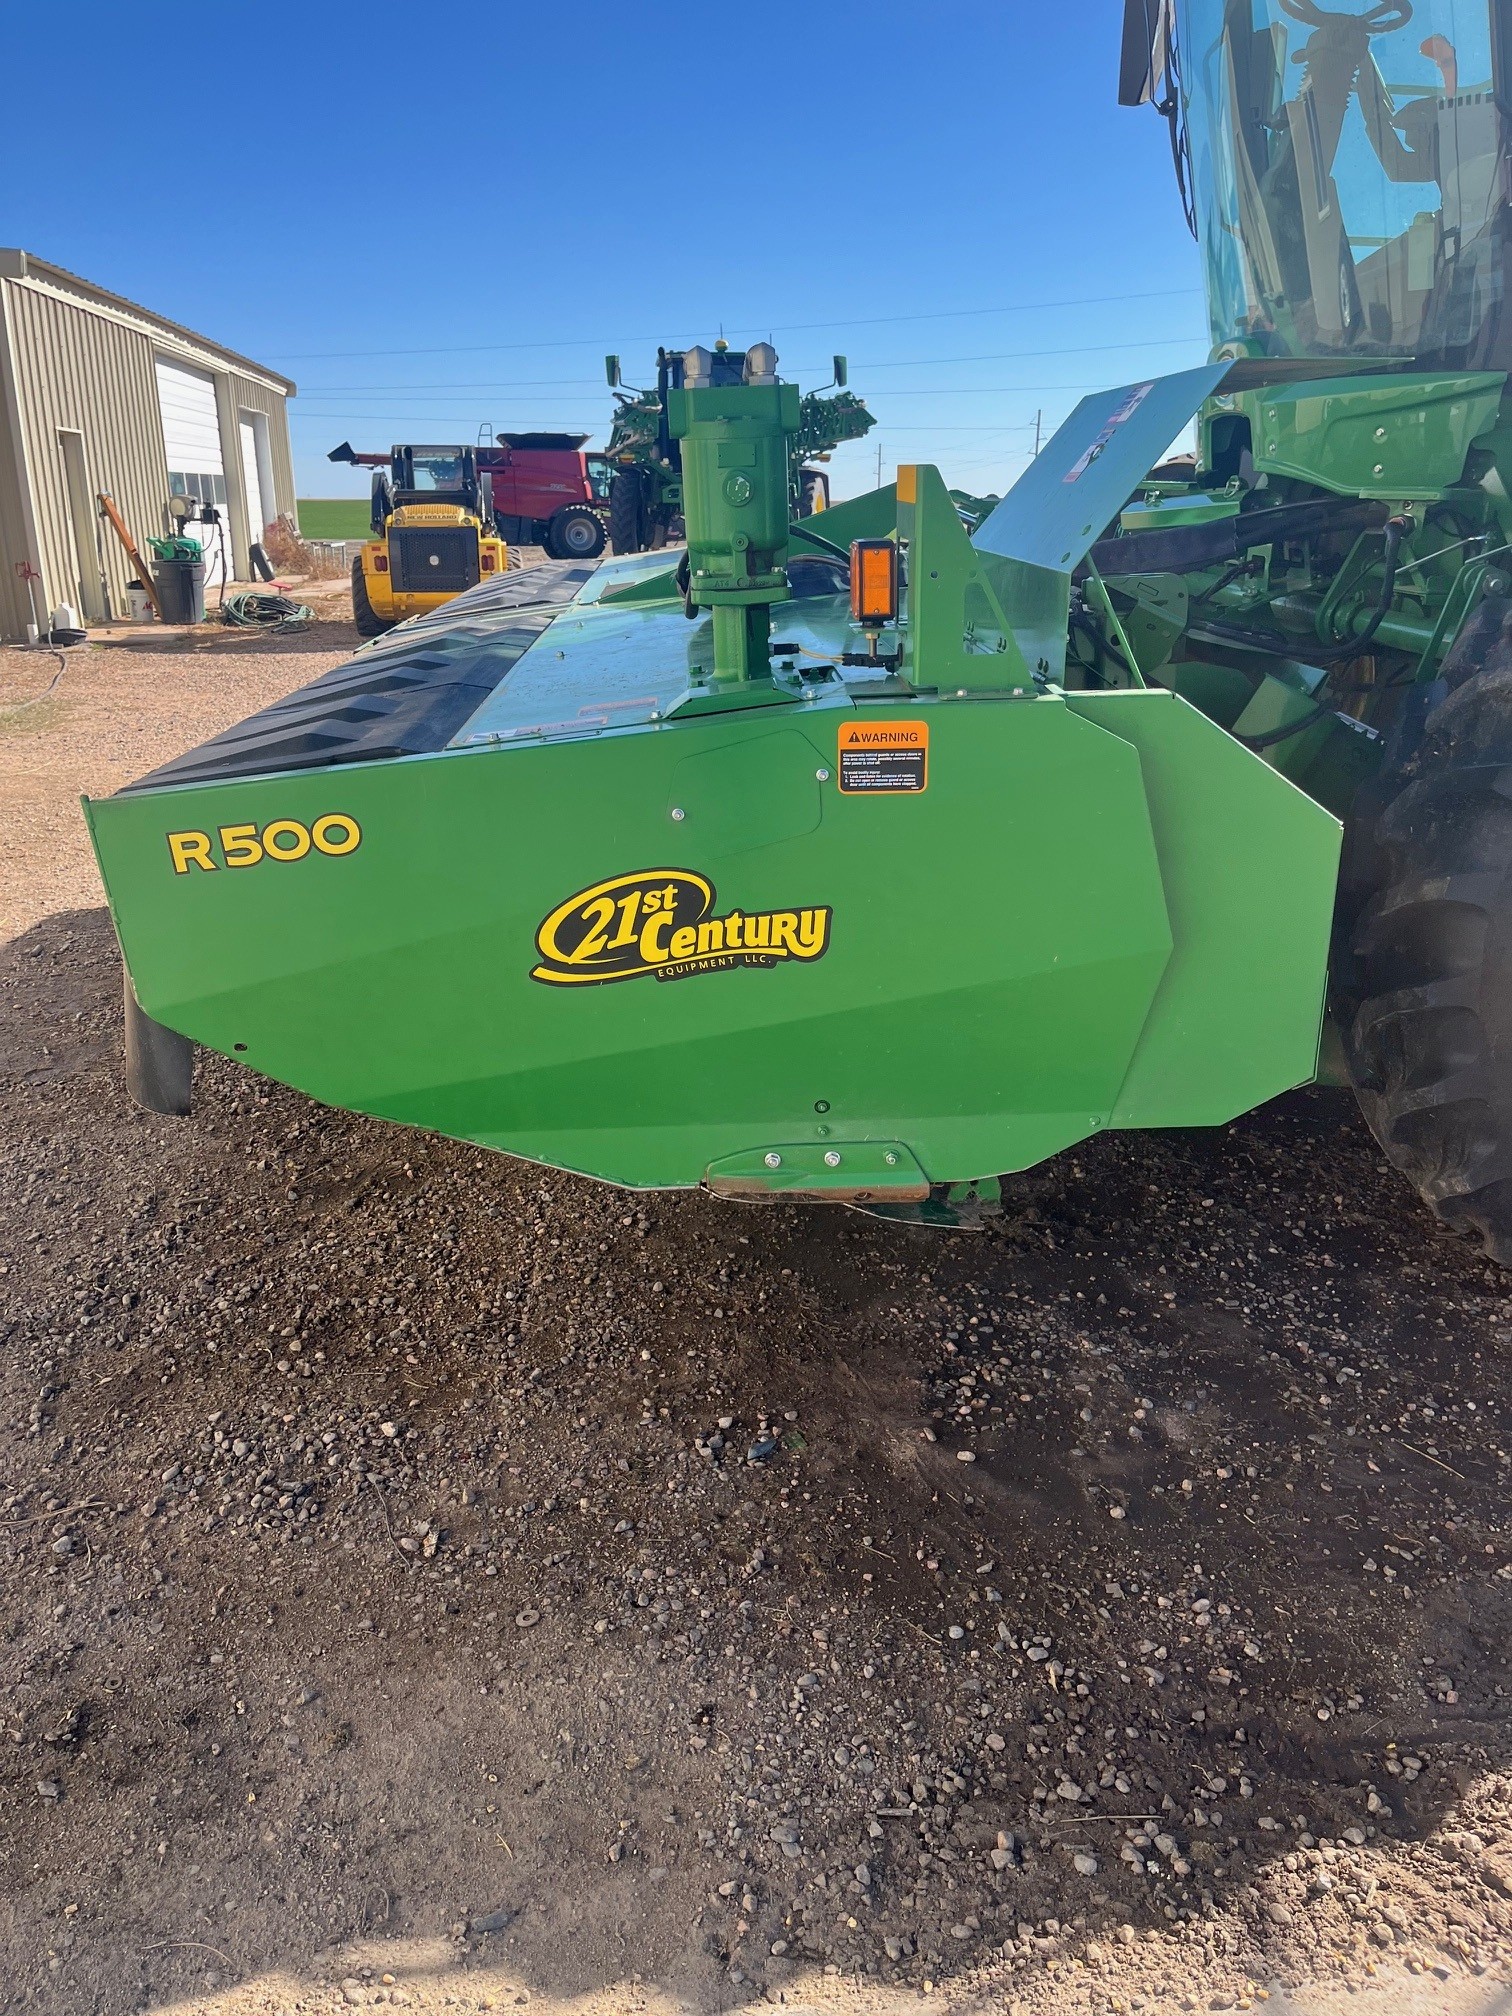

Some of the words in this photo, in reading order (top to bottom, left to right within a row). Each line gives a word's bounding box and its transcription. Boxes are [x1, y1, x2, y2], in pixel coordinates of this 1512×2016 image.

[861, 732, 918, 742] WARNING
[167, 813, 362, 875] R500
[569, 884, 678, 964] 21st
[639, 909, 828, 963] Century
[658, 957, 735, 978] EQUIPMENT
[745, 954, 772, 964] LLC.
